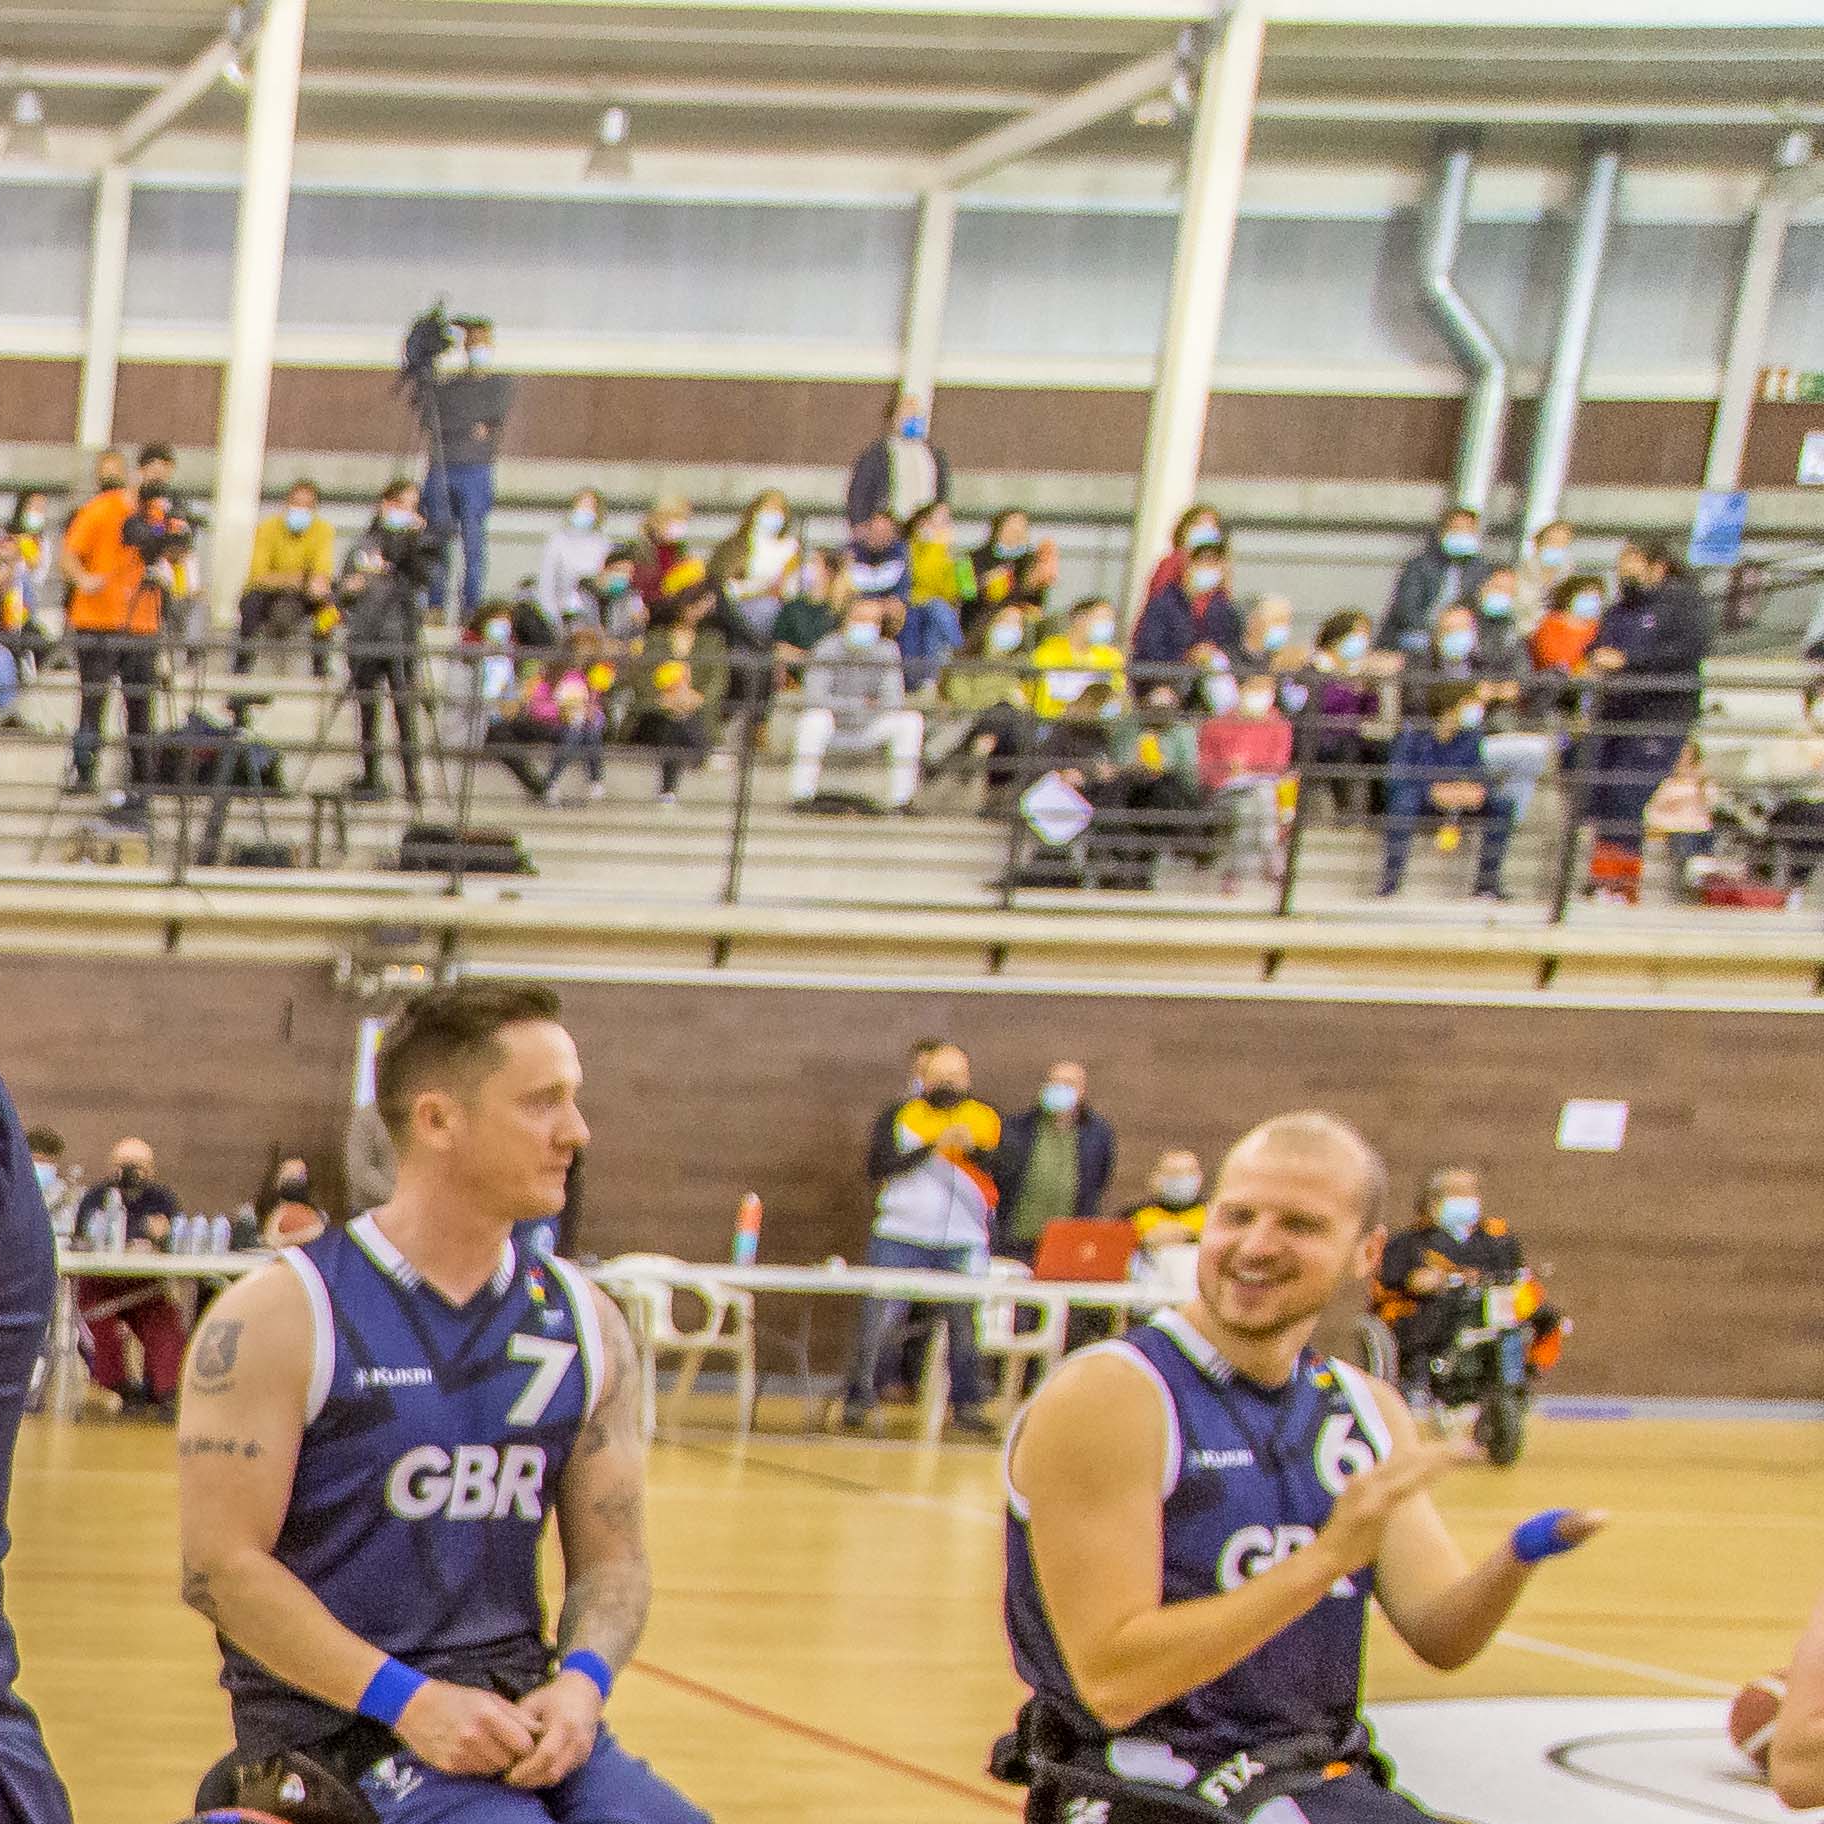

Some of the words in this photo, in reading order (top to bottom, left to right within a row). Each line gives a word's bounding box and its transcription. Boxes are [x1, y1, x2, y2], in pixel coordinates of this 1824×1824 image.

[507, 1333, 578, 1426] 7
[385, 1444, 546, 1520] GBR
[1314, 1413, 1375, 1497] 6
